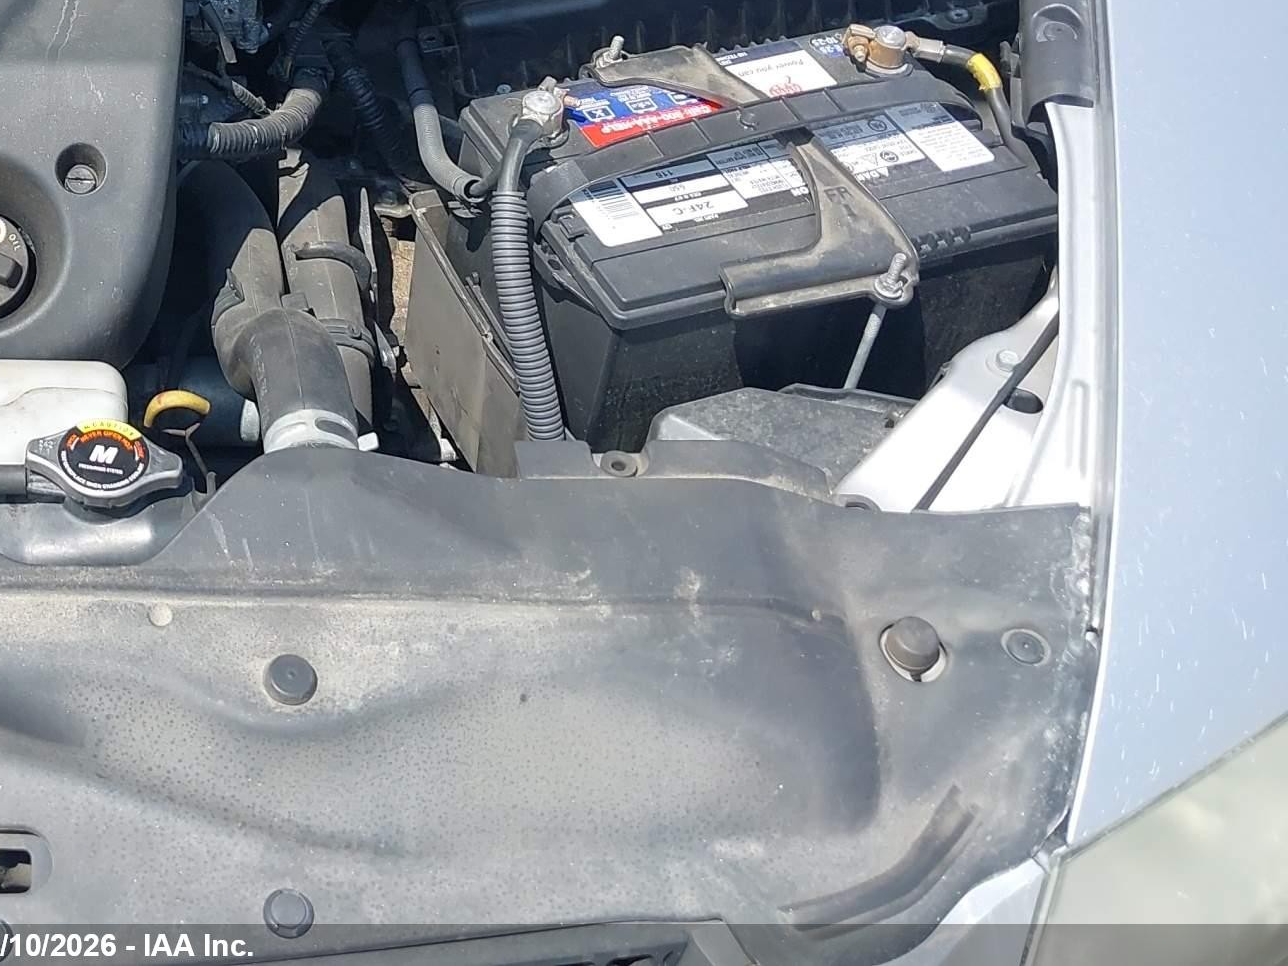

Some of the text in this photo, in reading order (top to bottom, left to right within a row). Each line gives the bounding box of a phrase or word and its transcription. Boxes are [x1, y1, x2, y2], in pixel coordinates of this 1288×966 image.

[738, 69, 754, 77] can
[756, 64, 773, 74] you
[673, 201, 715, 215] 24F-C
[9, 234, 21, 251] OIL
[89, 444, 118, 464] M
